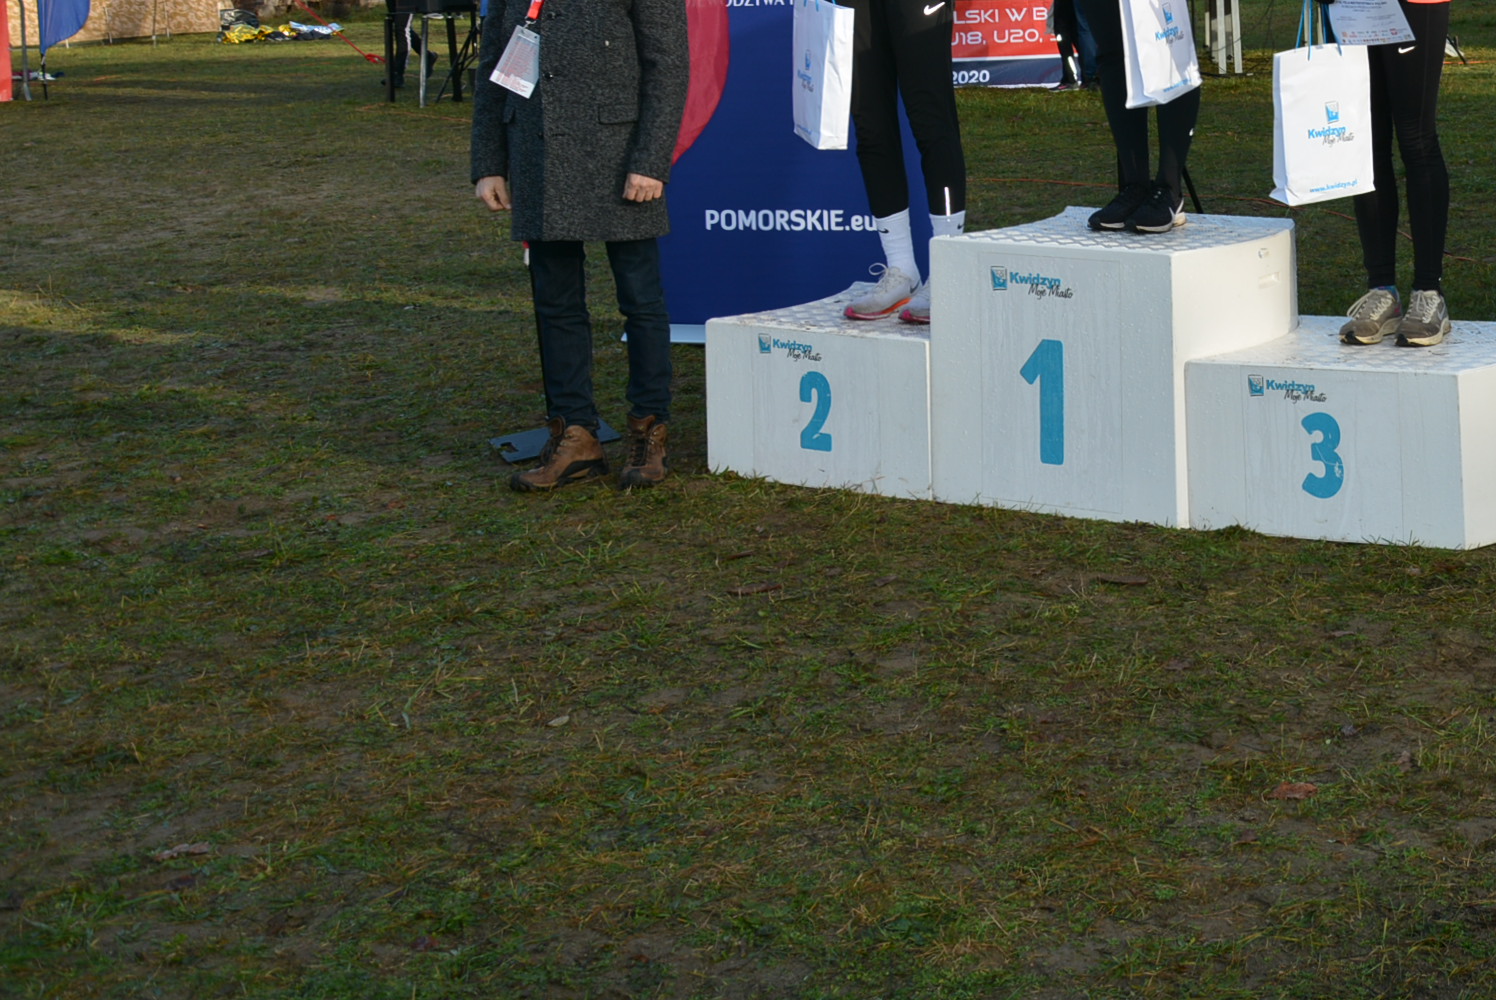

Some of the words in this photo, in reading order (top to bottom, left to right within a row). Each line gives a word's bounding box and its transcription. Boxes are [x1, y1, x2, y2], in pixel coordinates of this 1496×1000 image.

[953, 9, 999, 24] LSKI
[1308, 125, 1346, 142] Kwidzyn
[705, 208, 878, 232] POMORSKIE.eu
[1010, 272, 1061, 288] Kwidzyn
[1028, 283, 1047, 300] Moje
[772, 338, 813, 352] Kwidzyn
[1266, 378, 1315, 395] Kwidzyn
[1019, 338, 1065, 466] 1
[800, 371, 832, 452] 2
[1301, 412, 1345, 499] 3
